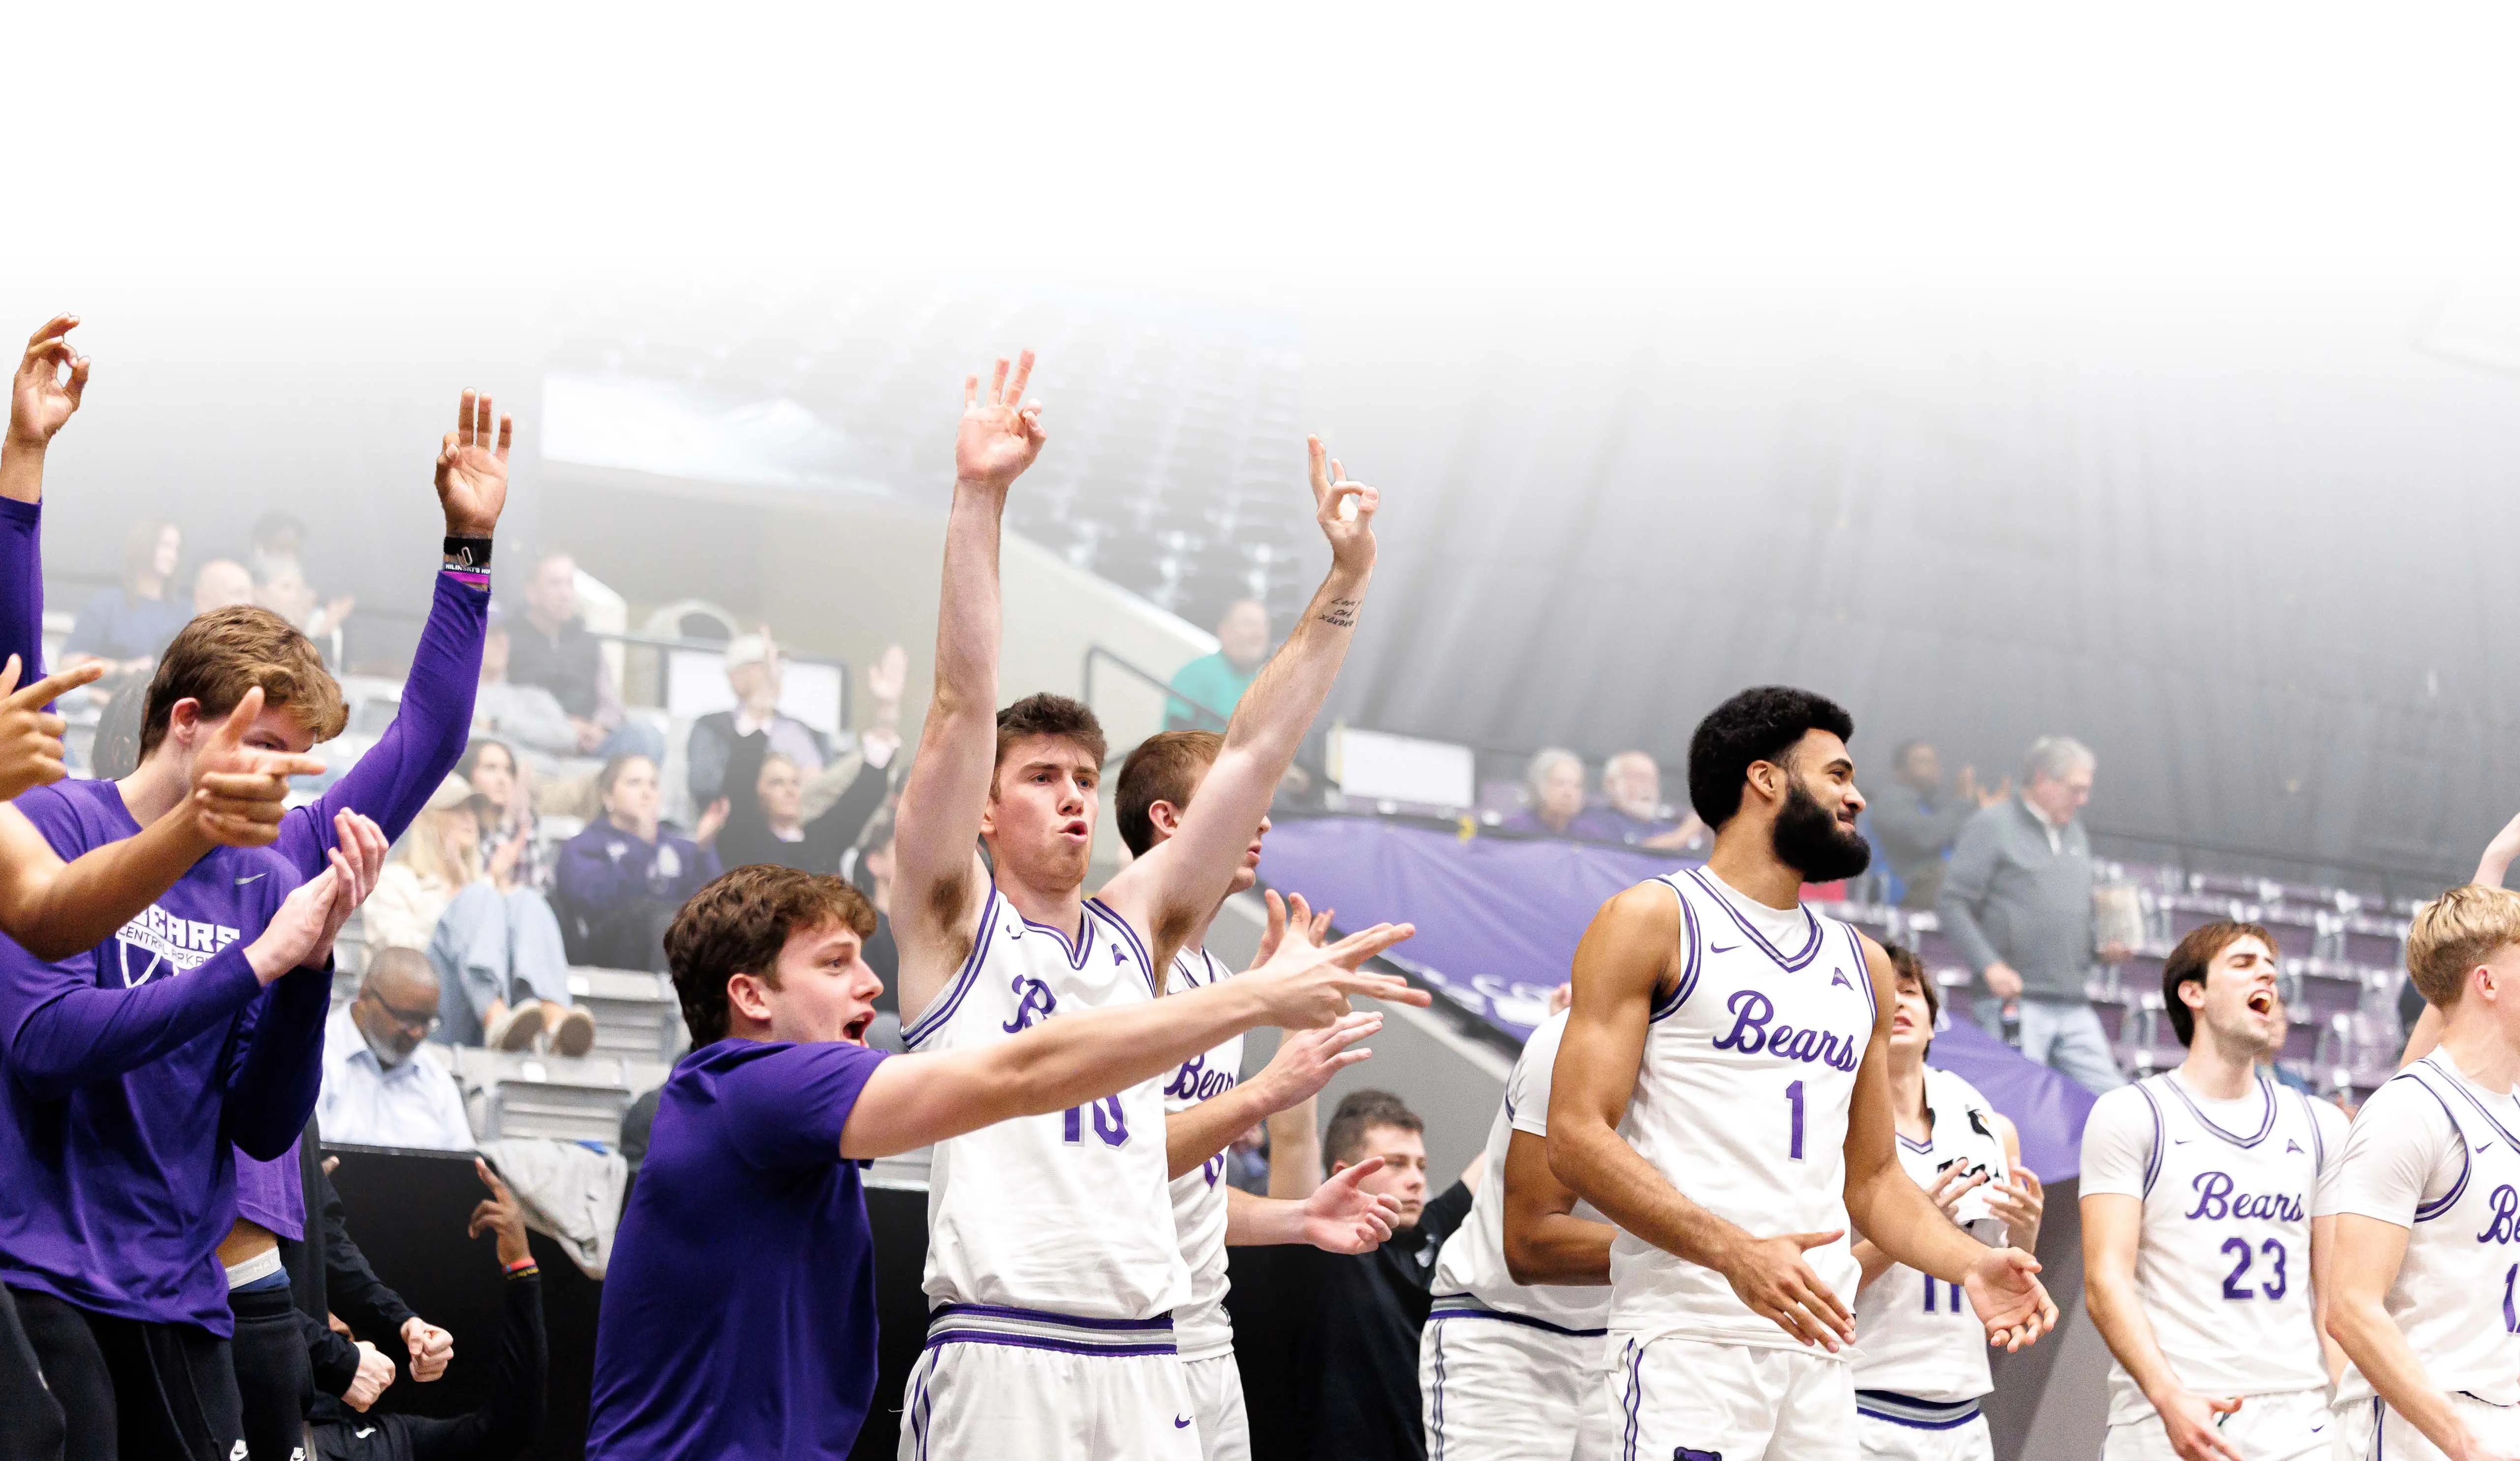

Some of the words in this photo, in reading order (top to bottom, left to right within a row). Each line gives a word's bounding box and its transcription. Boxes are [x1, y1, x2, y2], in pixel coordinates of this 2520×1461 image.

[1712, 989, 1858, 1072] Bears
[1785, 1079, 1804, 1161] 1
[2185, 1171, 2304, 1222] Bears
[2221, 1237, 2287, 1301] 23
